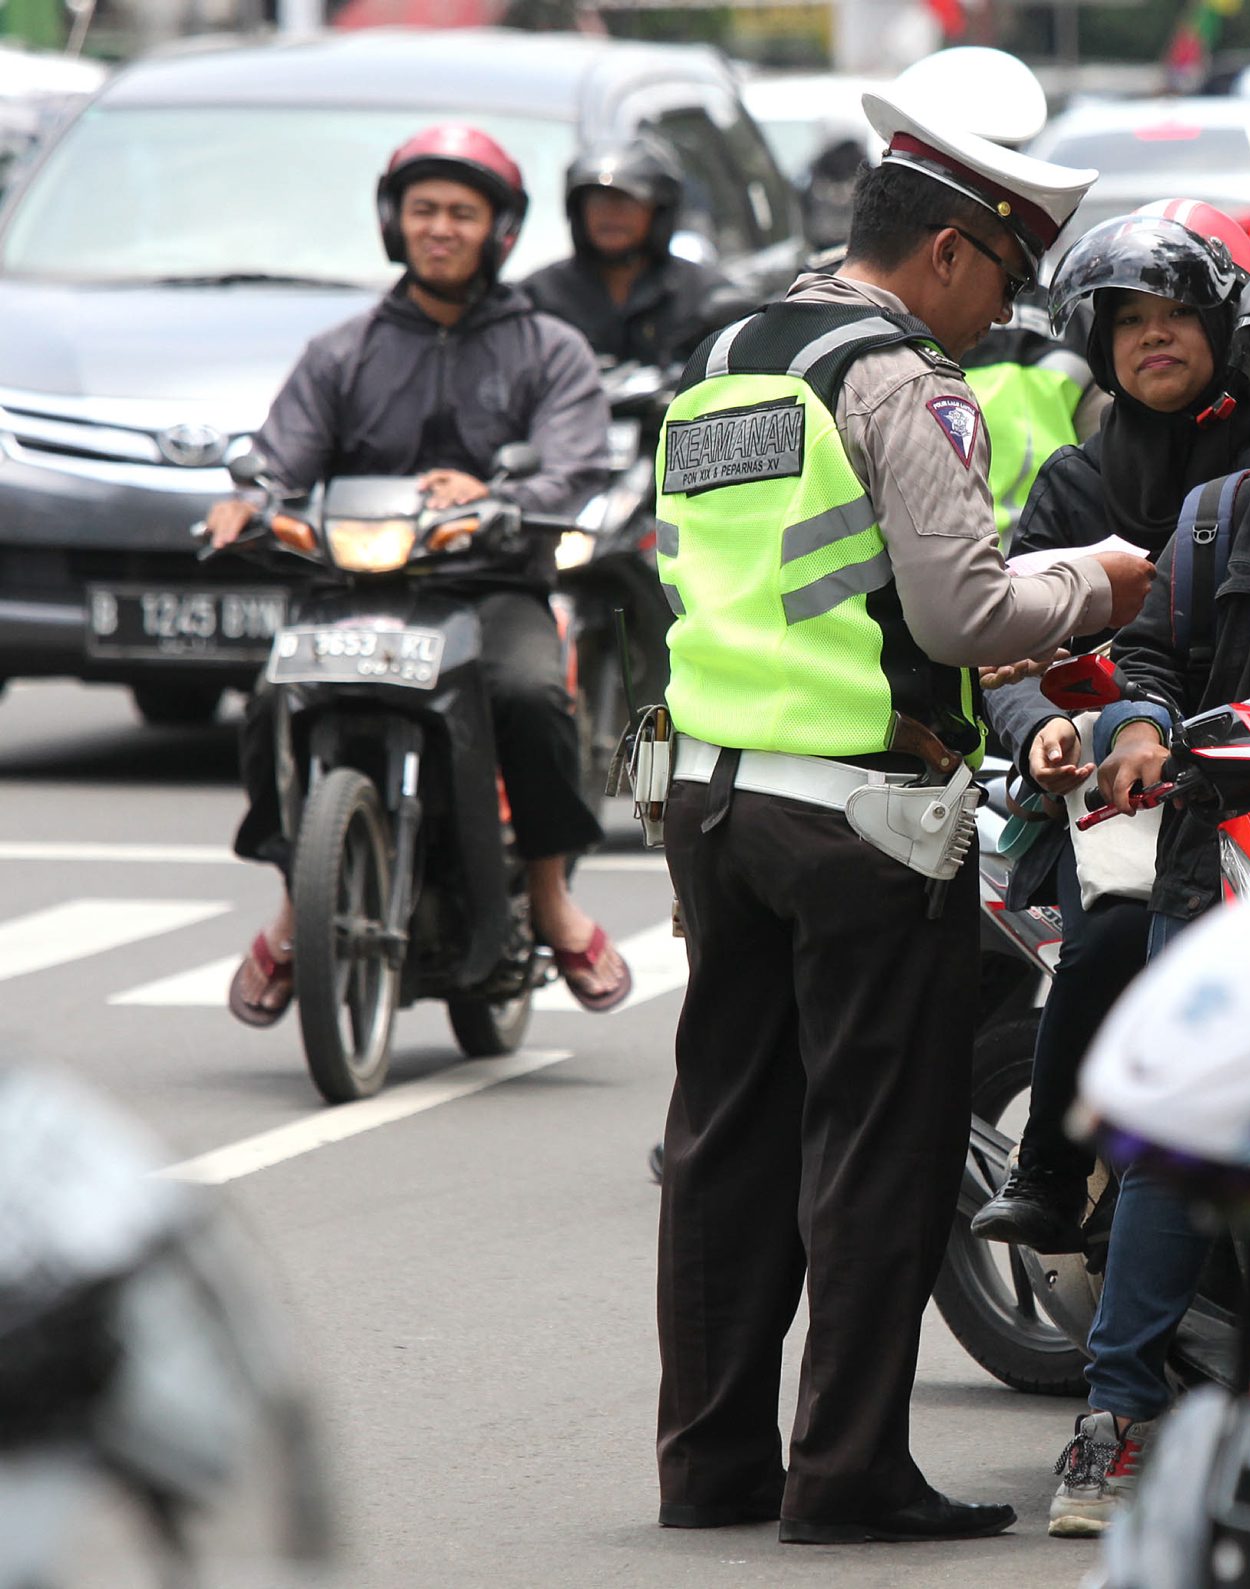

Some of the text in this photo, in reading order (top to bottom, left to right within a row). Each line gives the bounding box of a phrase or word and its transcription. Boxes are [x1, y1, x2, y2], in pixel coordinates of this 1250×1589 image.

[669, 411, 801, 472] KEAMANAN
[683, 470, 697, 485] PON
[700, 467, 711, 481] XIX
[721, 460, 763, 477] PEPARNAS
[767, 458, 780, 471] XV
